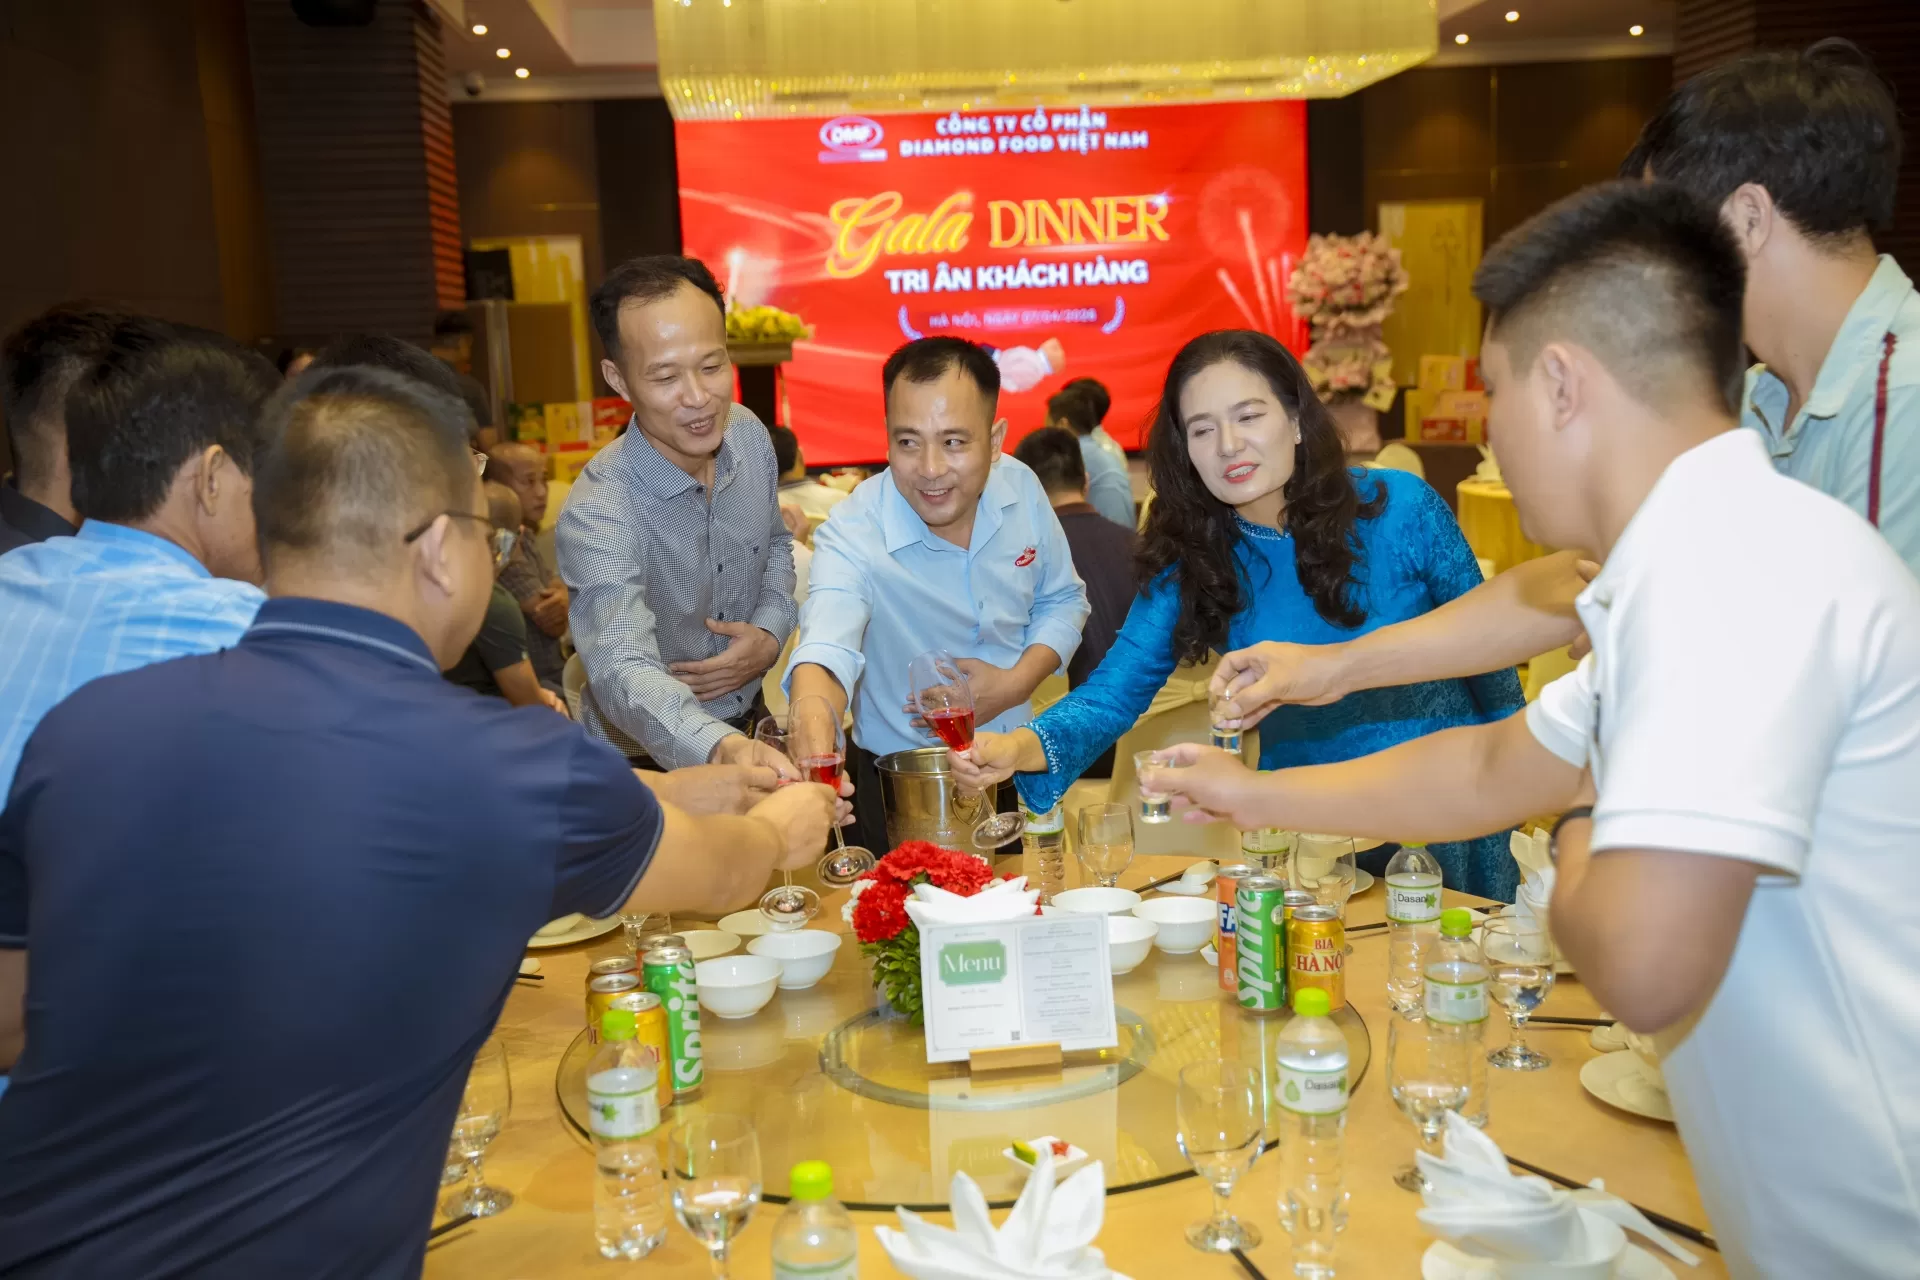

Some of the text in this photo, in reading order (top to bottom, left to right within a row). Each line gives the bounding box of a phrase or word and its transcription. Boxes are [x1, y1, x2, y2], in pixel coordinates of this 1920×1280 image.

[936, 104, 1106, 135] CÔNG TY CỔ PHẦN
[900, 138, 995, 157] DIAMOND
[998, 135, 1054, 153] FOOD
[1057, 130, 1100, 155] VIỆT
[1103, 131, 1149, 150] NAM
[825, 191, 1170, 279] Gala DINNER
[884, 255, 1149, 293] TRI ÂN KHÁCH HÀNG
[929, 313, 949, 327] HÀ
[1397, 893, 1428, 903] Dasan
[1315, 938, 1334, 950] BIA
[944, 952, 1001, 974] Menu
[1296, 953, 1320, 972] HÀ
